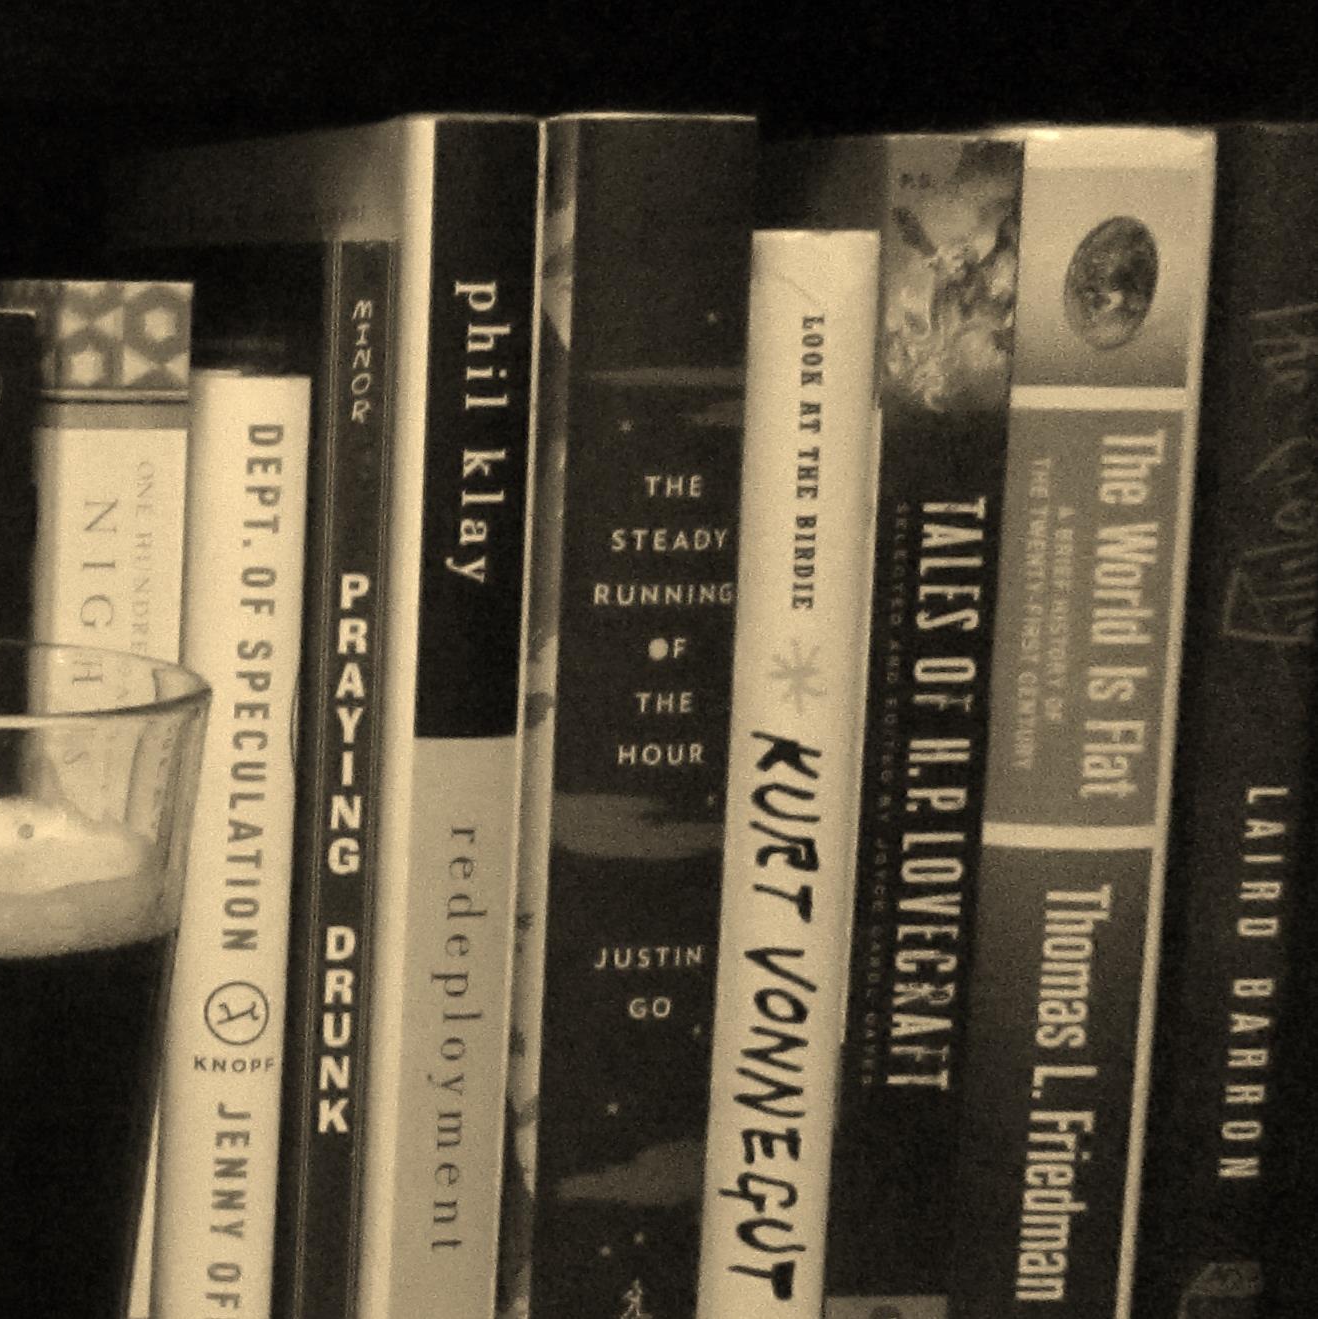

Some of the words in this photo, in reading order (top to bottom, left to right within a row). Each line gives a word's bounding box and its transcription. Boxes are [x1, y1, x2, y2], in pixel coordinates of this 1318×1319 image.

[351, 300, 374, 424] MINOR
[454, 279, 512, 411] phil
[798, 314, 826, 387] LOOK
[798, 401, 823, 436] AT
[133, 460, 156, 514] ONE
[242, 422, 285, 548] DEPT.
[644, 475, 704, 498] THE
[795, 446, 821, 501] THE
[1030, 458, 1051, 497] THE
[1100, 428, 1164, 505] The
[445, 447, 507, 584] klay
[610, 528, 729, 554] STEADY
[240, 566, 278, 616] OF
[593, 582, 734, 607] RUNNING
[792, 514, 819, 611] BIRDIE
[914, 496, 988, 633] TALES
[1091, 523, 1160, 645] World
[912, 655, 978, 713] OF
[1047, 600, 1071, 688] HISTORY
[1087, 665, 1151, 701] Is
[327, 571, 370, 875] PRAYING
[636, 692, 695, 715] THE
[1013, 672, 1039, 770] CENTURY
[221, 638, 274, 951] SPECULATION
[617, 743, 706, 766] HOUR
[1081, 719, 1145, 800] Flat
[749, 730, 824, 925] KURT
[1235, 785, 1290, 938] LAIRD
[594, 945, 706, 971] JUSTIN
[887, 831, 965, 1092] LOVECRAFT
[1034, 884, 1112, 1049] Thomas
[318, 925, 356, 1135] DRUNK
[427, 824, 488, 1253] redeployment
[629, 997, 672, 1020] GO
[194, 1055, 276, 1074] KNOPF
[1030, 1065, 1098, 1099] L.
[1218, 978, 1275, 1180] BARRON
[719, 946, 821, 1302] VONNEGUT
[209, 1102, 252, 1240] JENNY
[1016, 1110, 1097, 1303] Friedman
